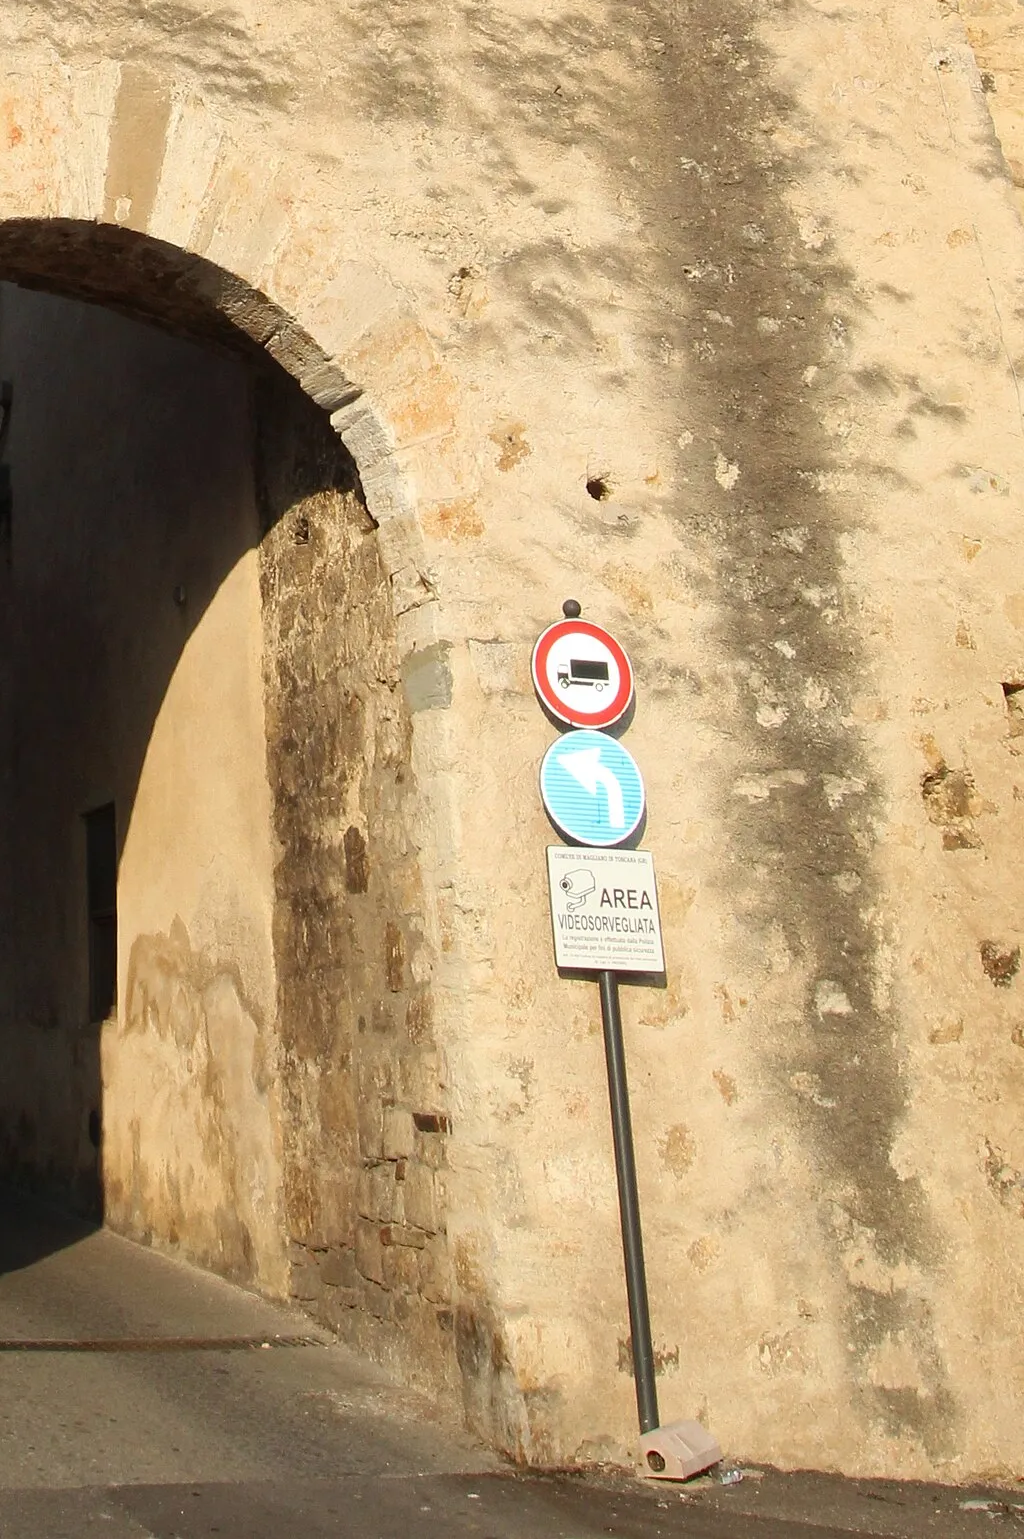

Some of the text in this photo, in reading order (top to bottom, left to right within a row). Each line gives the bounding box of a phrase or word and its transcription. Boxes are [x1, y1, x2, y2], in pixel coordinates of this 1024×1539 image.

[583, 853, 608, 862] MAGLIANO
[600, 888, 653, 910] AREA
[557, 913, 656, 934] VIDEOSORVEGLIATA
